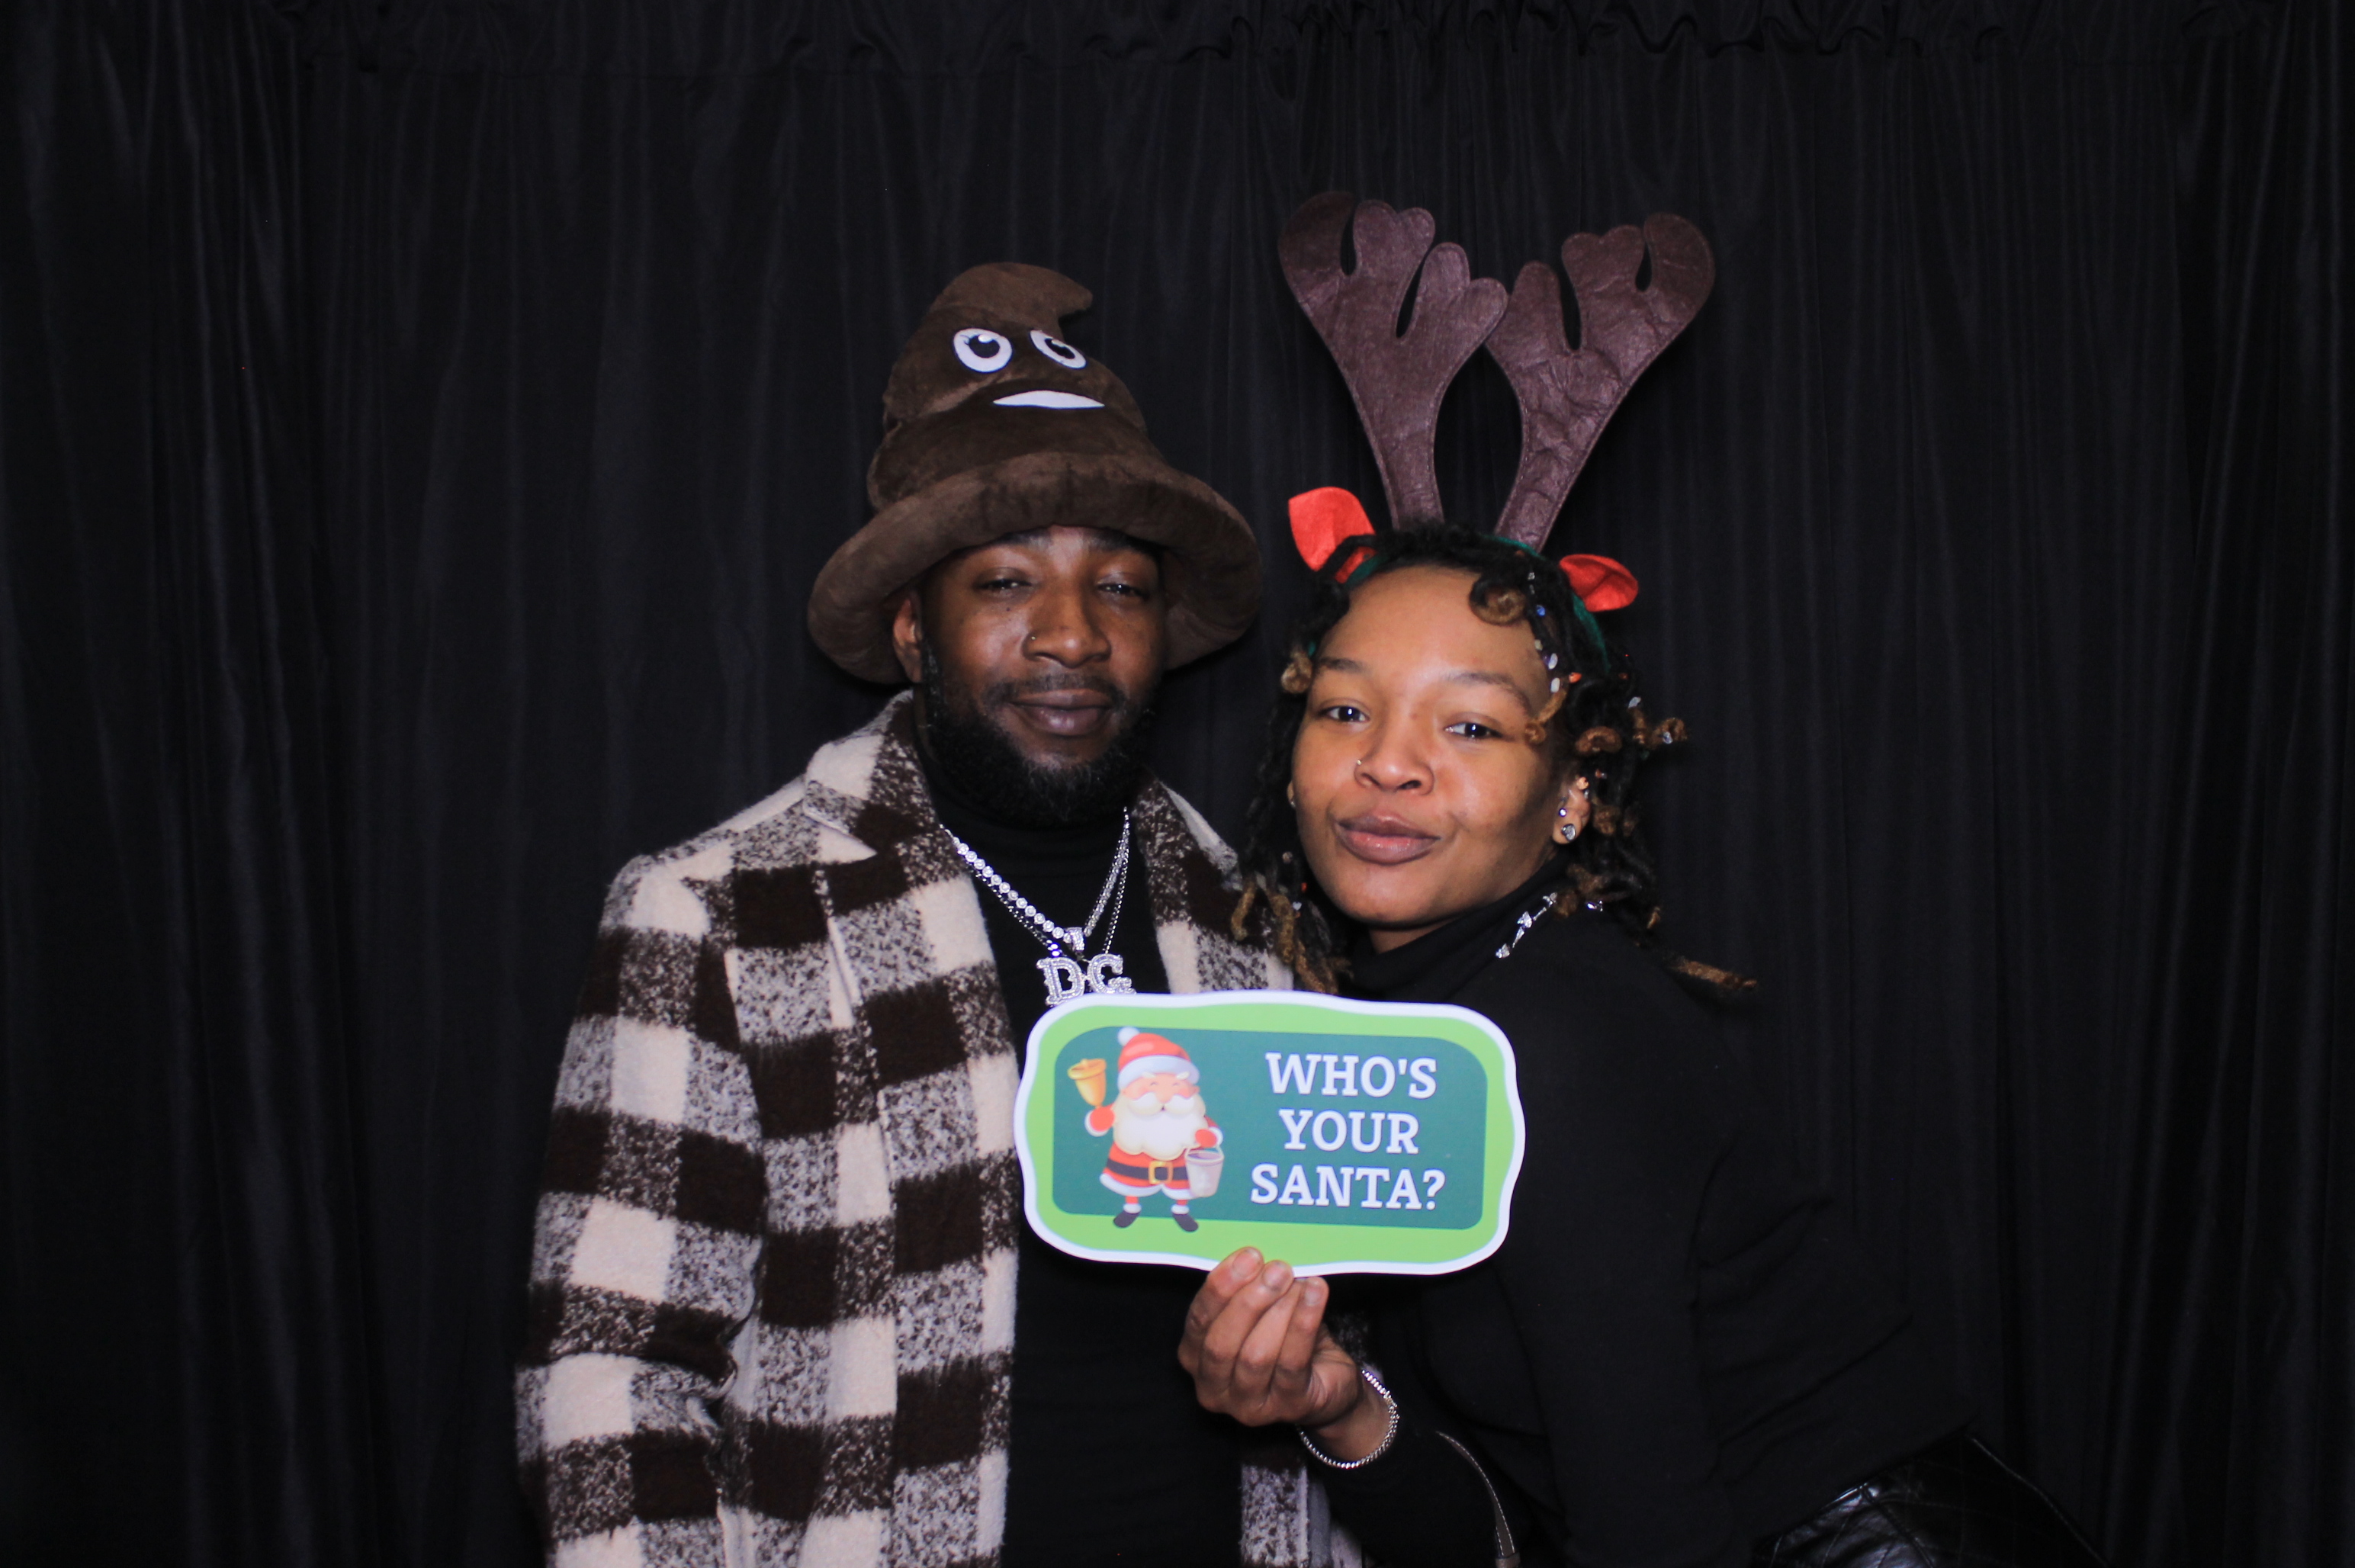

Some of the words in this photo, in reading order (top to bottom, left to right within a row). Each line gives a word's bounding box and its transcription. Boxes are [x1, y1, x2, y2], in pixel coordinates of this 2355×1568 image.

[1036, 953, 1136, 1007] DG
[1264, 1052, 1438, 1100] WHO'S
[1278, 1108, 1420, 1155] YOUR
[1250, 1163, 1446, 1211] SANTA?
